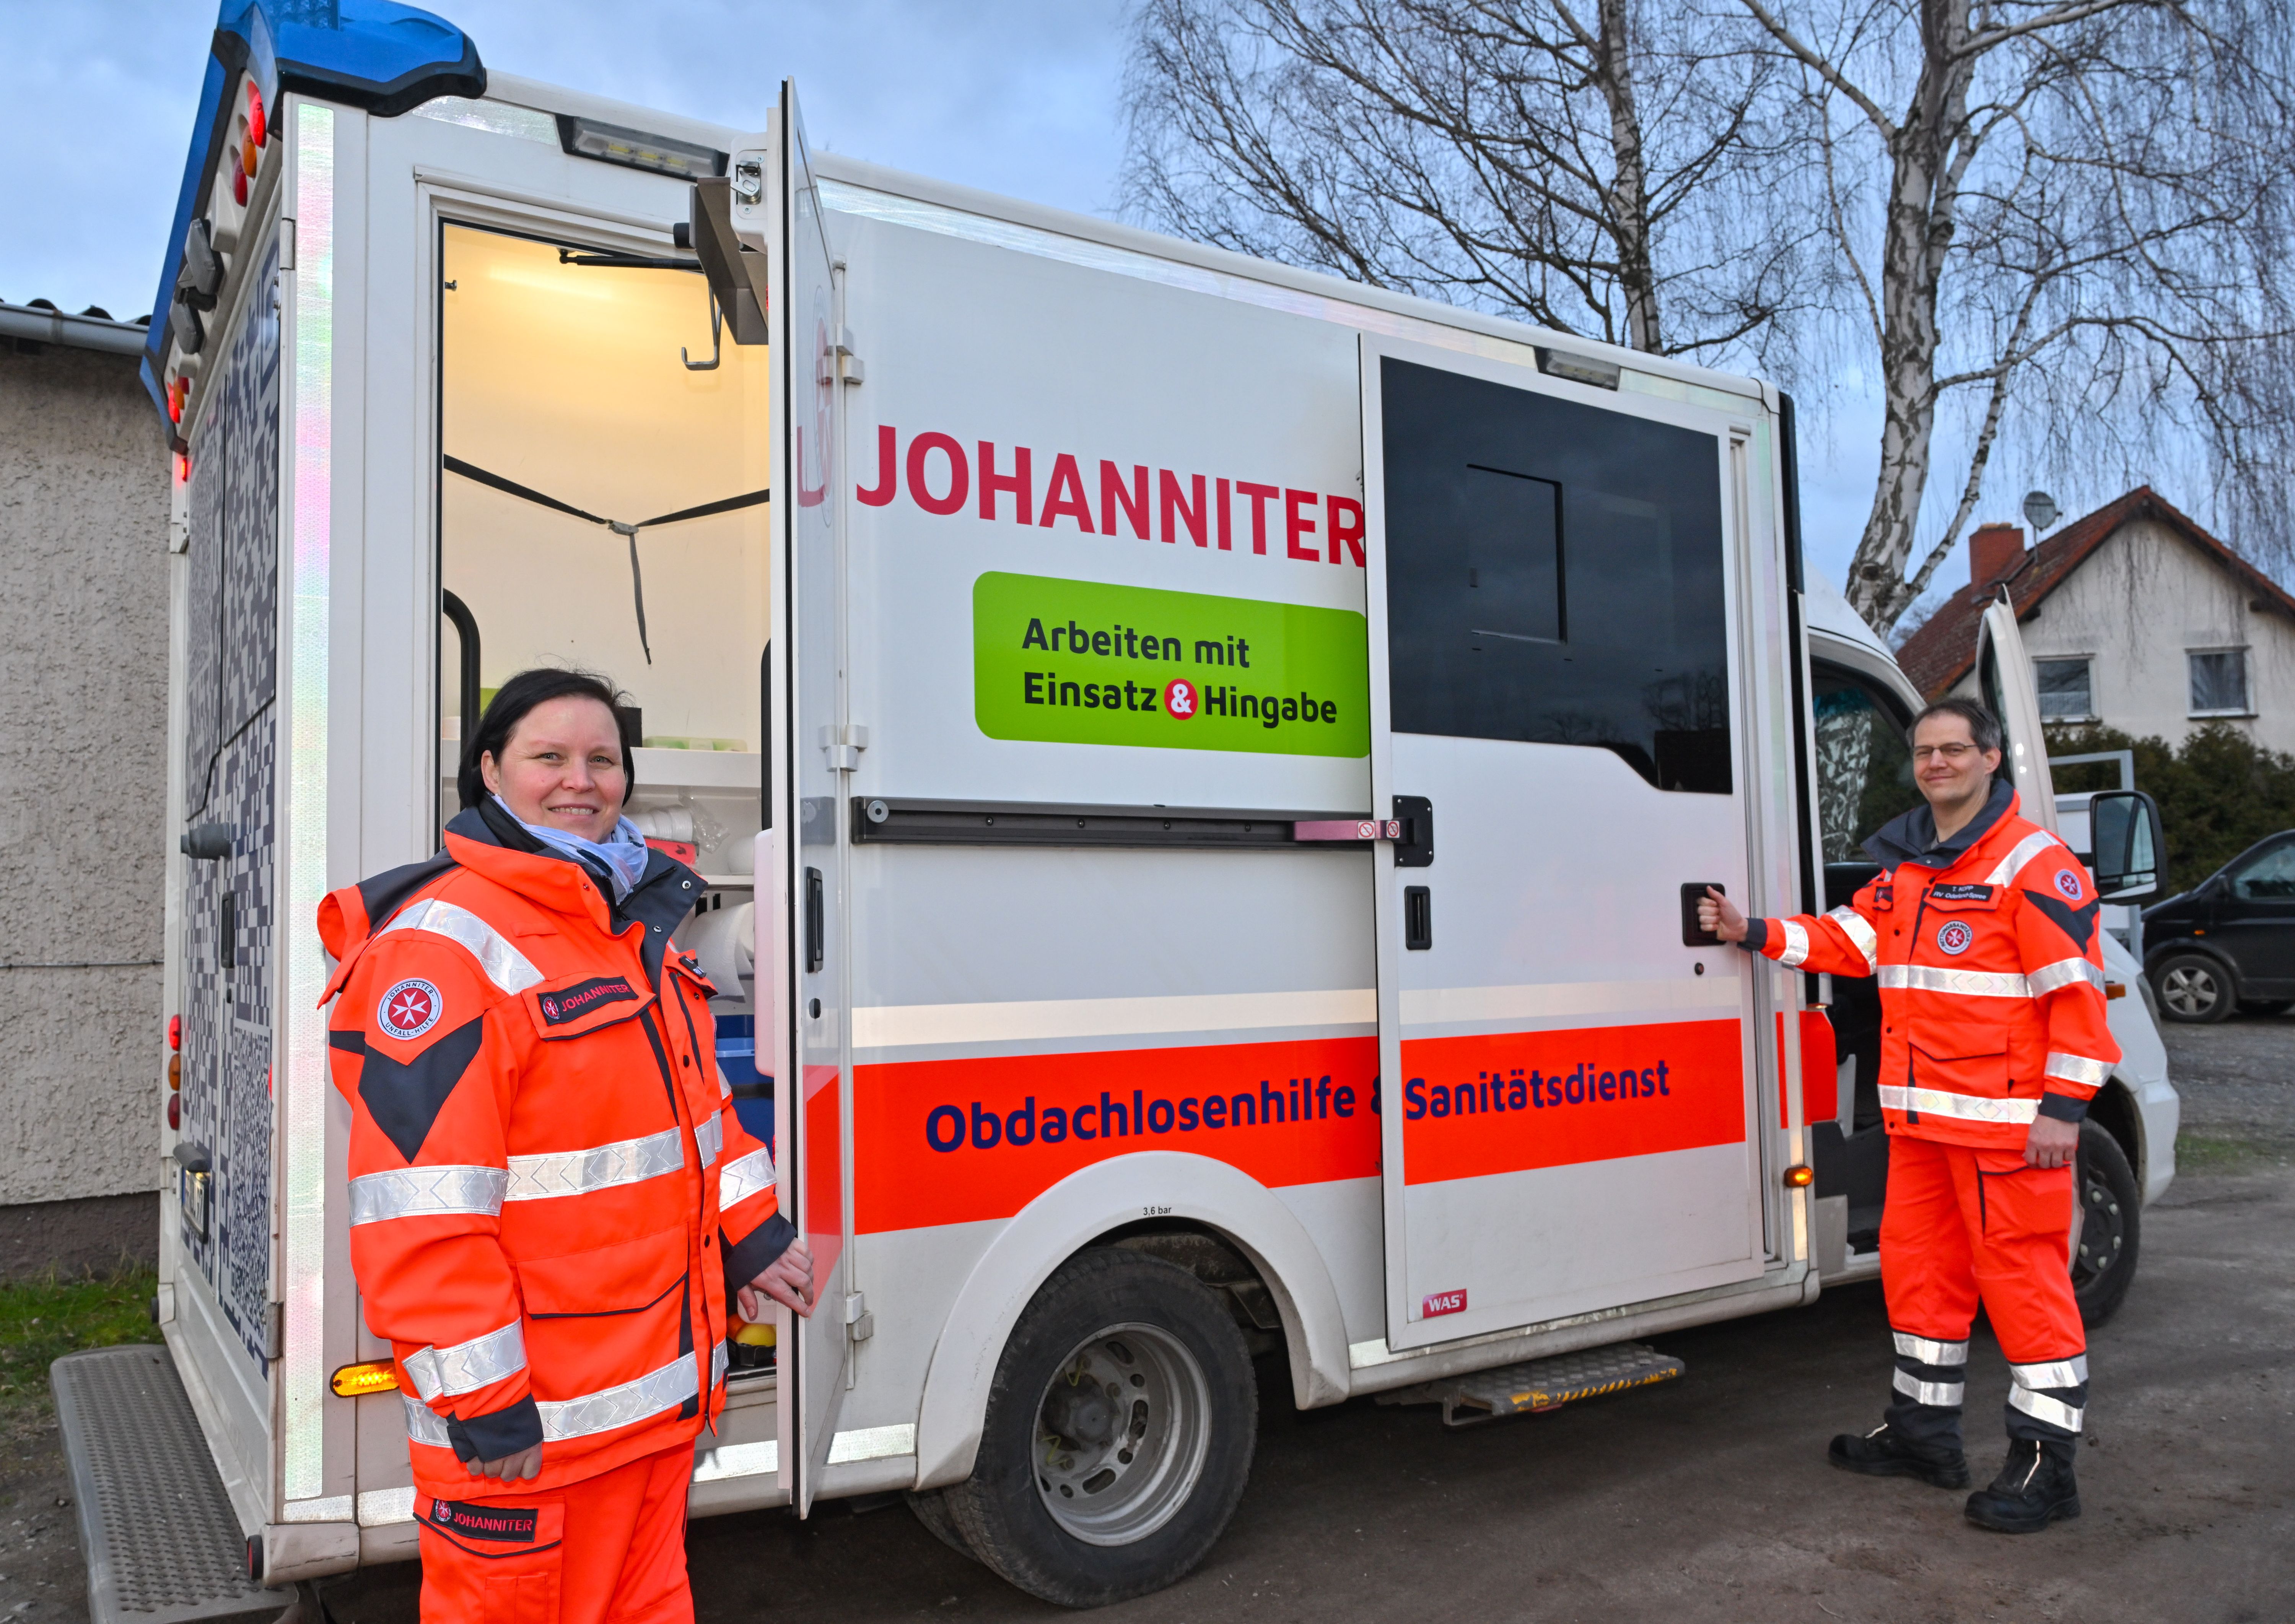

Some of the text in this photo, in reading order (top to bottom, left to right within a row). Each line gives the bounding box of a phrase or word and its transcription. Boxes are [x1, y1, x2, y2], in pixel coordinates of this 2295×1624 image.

[857, 425, 1364, 567] JOHANNITER
[1022, 618, 1250, 668] Arbeiten mit
[1024, 671, 1337, 729] Einsatz & Hingabe
[561, 984, 631, 1012] JOHANNITER
[386, 1017, 433, 1036] UNFALL-HILFE
[1405, 1061, 1669, 1120] Sanitätsdienst
[926, 1075, 1356, 1153] Obdachlosenhilfe
[1143, 1206, 1172, 1216] 3,6 bar
[1429, 1294, 1460, 1312] WAS
[454, 1513, 532, 1531] JOHANNITER
